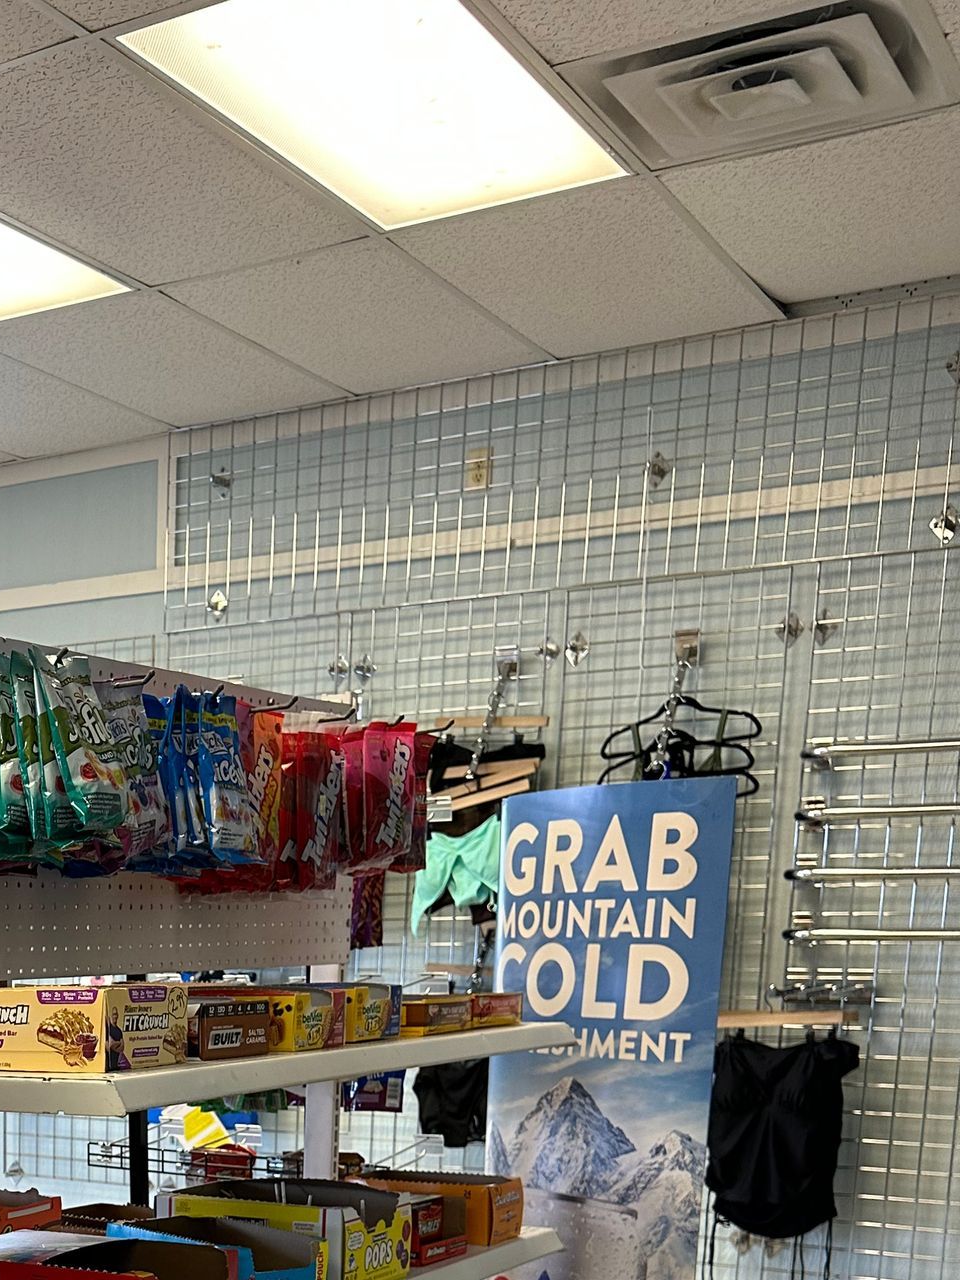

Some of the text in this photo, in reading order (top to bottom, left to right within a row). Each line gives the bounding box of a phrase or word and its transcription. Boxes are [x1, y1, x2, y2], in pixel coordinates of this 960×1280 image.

[504, 811, 699, 897] GRAB
[501, 898, 697, 940] MOUNTAIN
[497, 942, 690, 1021] COLD
[123, 1005, 138, 1014] ROBERT
[208, 1006, 215, 1014] 12
[217, 1005, 226, 1014] 130
[227, 1005, 234, 1013] 17
[237, 1004, 242, 1012] 4
[246, 1004, 251, 1012] 4
[123, 1013, 170, 1032] FITCRUNCH
[213, 1029, 242, 1047] BUILT
[245, 1036, 268, 1045] CARAMEL
[248, 1028, 266, 1037] SALTED
[316, 1250, 325, 1280] POUCH
[364, 1238, 394, 1273] POPS
